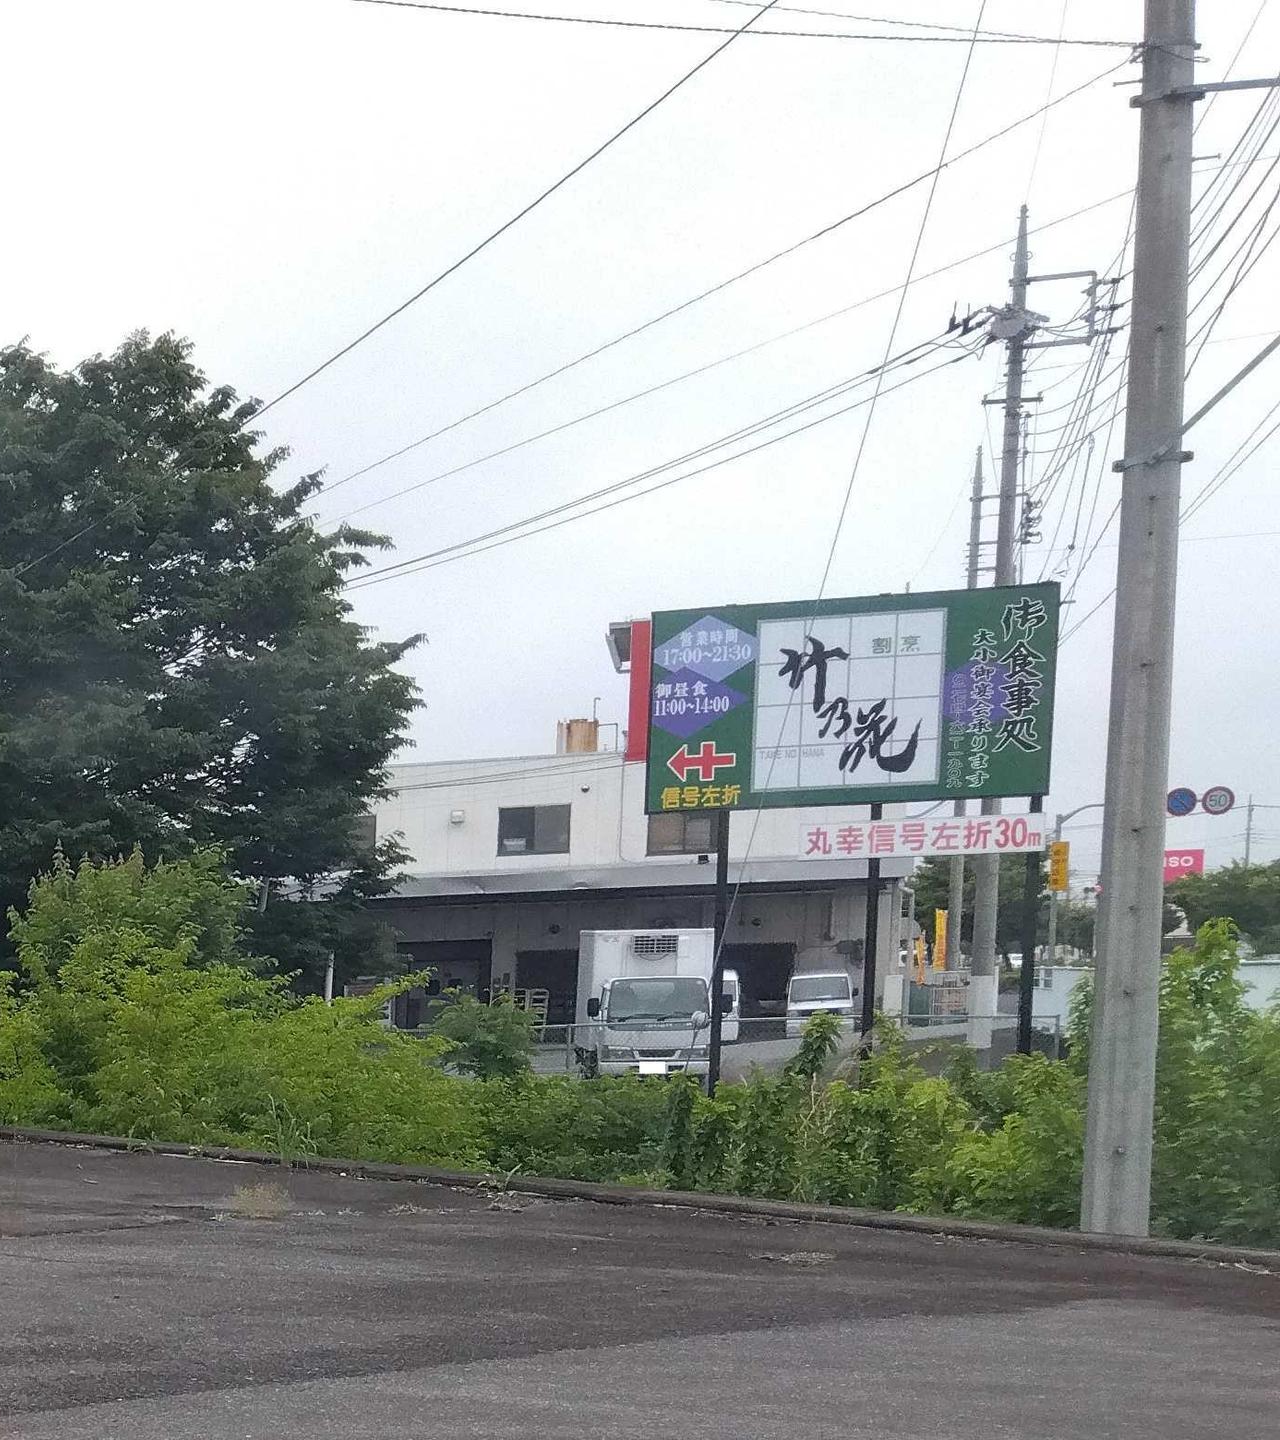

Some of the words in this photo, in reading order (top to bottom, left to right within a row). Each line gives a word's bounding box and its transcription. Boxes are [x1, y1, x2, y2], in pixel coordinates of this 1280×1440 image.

[680, 628, 739, 648] 営業時間
[871, 635, 921, 654] 割烹
[654, 680, 709, 699] 御昼食
[660, 784, 742, 810] 信号左折
[805, 817, 1042, 856] 丸幸信号左折30m
